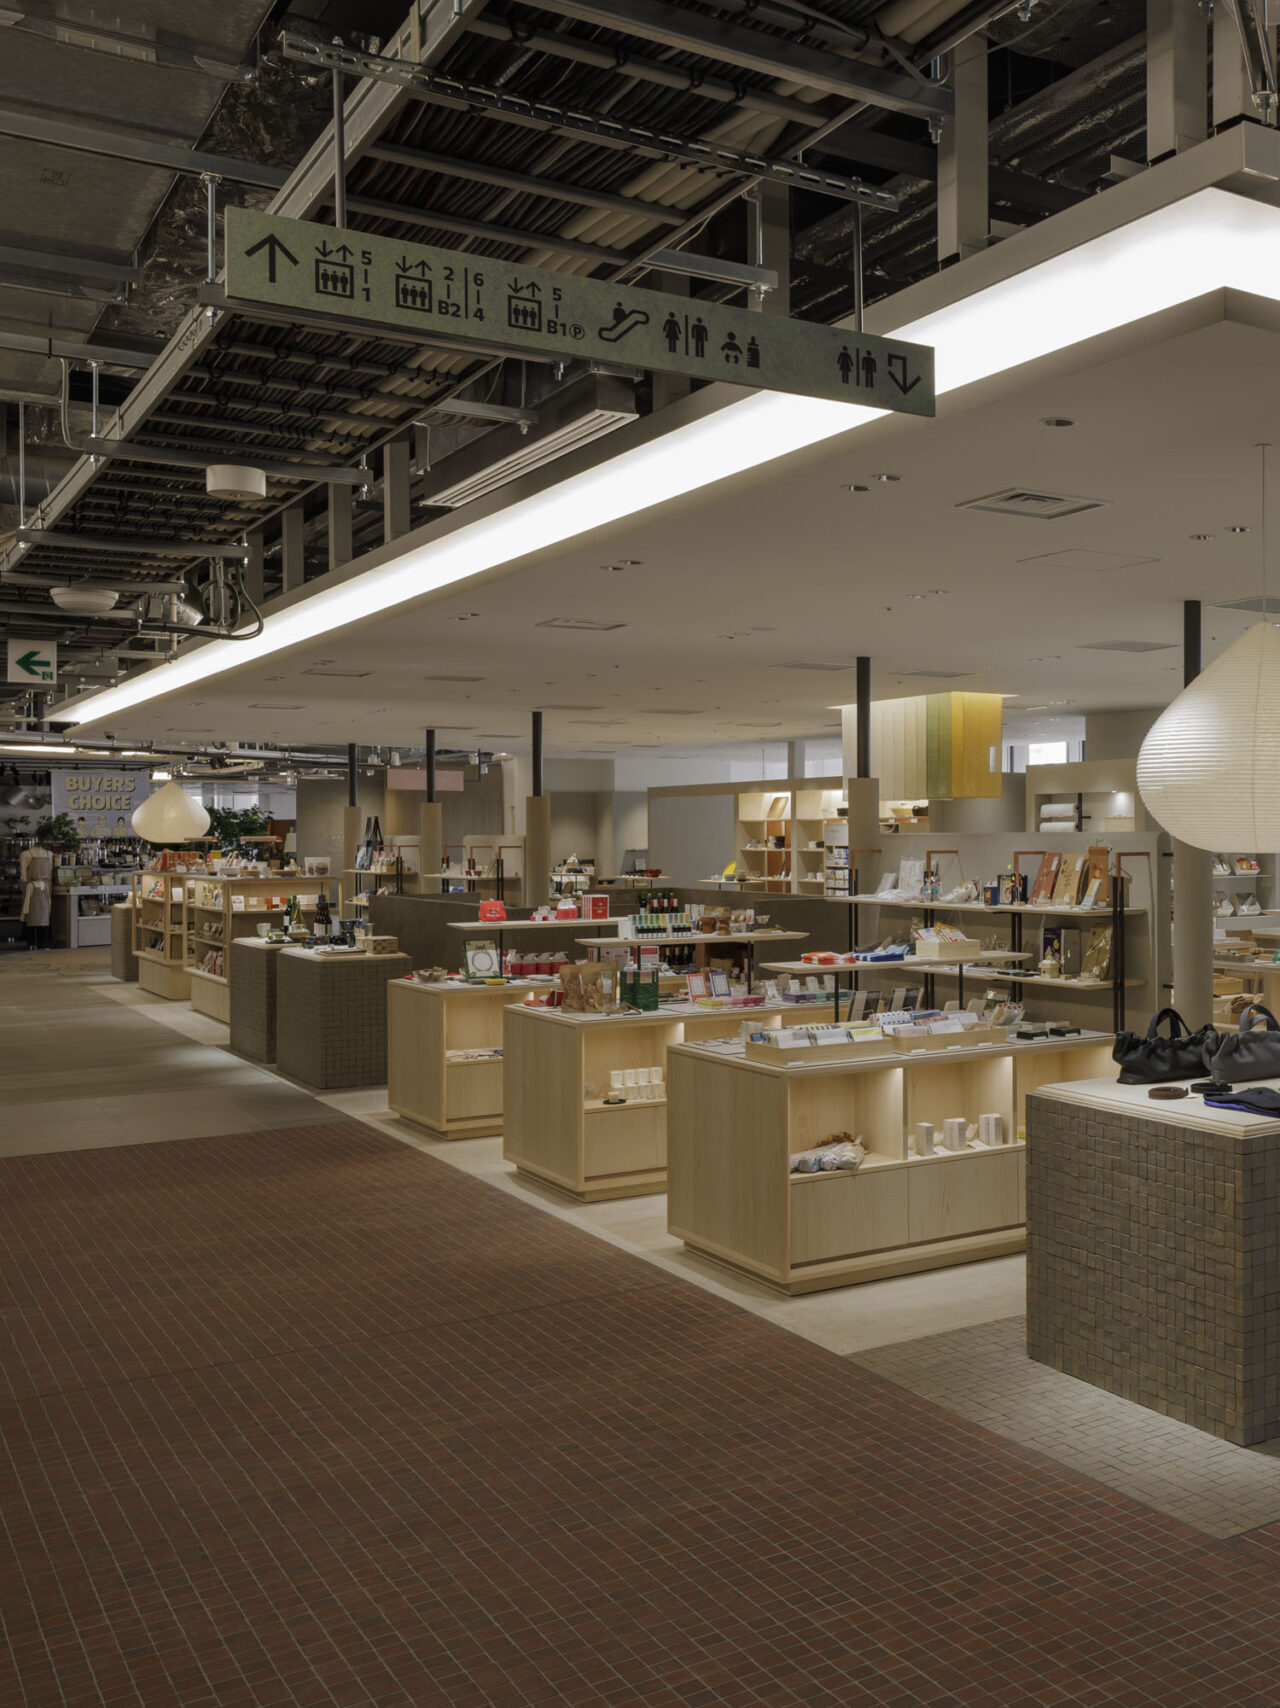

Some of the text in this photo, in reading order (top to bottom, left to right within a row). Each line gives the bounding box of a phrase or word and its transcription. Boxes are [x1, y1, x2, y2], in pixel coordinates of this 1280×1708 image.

[361, 250, 372, 266] 5
[443, 266, 454, 281] 2
[473, 272, 484, 287] 6
[362, 287, 371, 302] 1
[552, 287, 562, 301] 5
[438, 300, 461, 318] B2
[473, 308, 485, 321] 4
[65, 775, 136, 792] BUYERS
[69, 794, 131, 810] CHOICE
